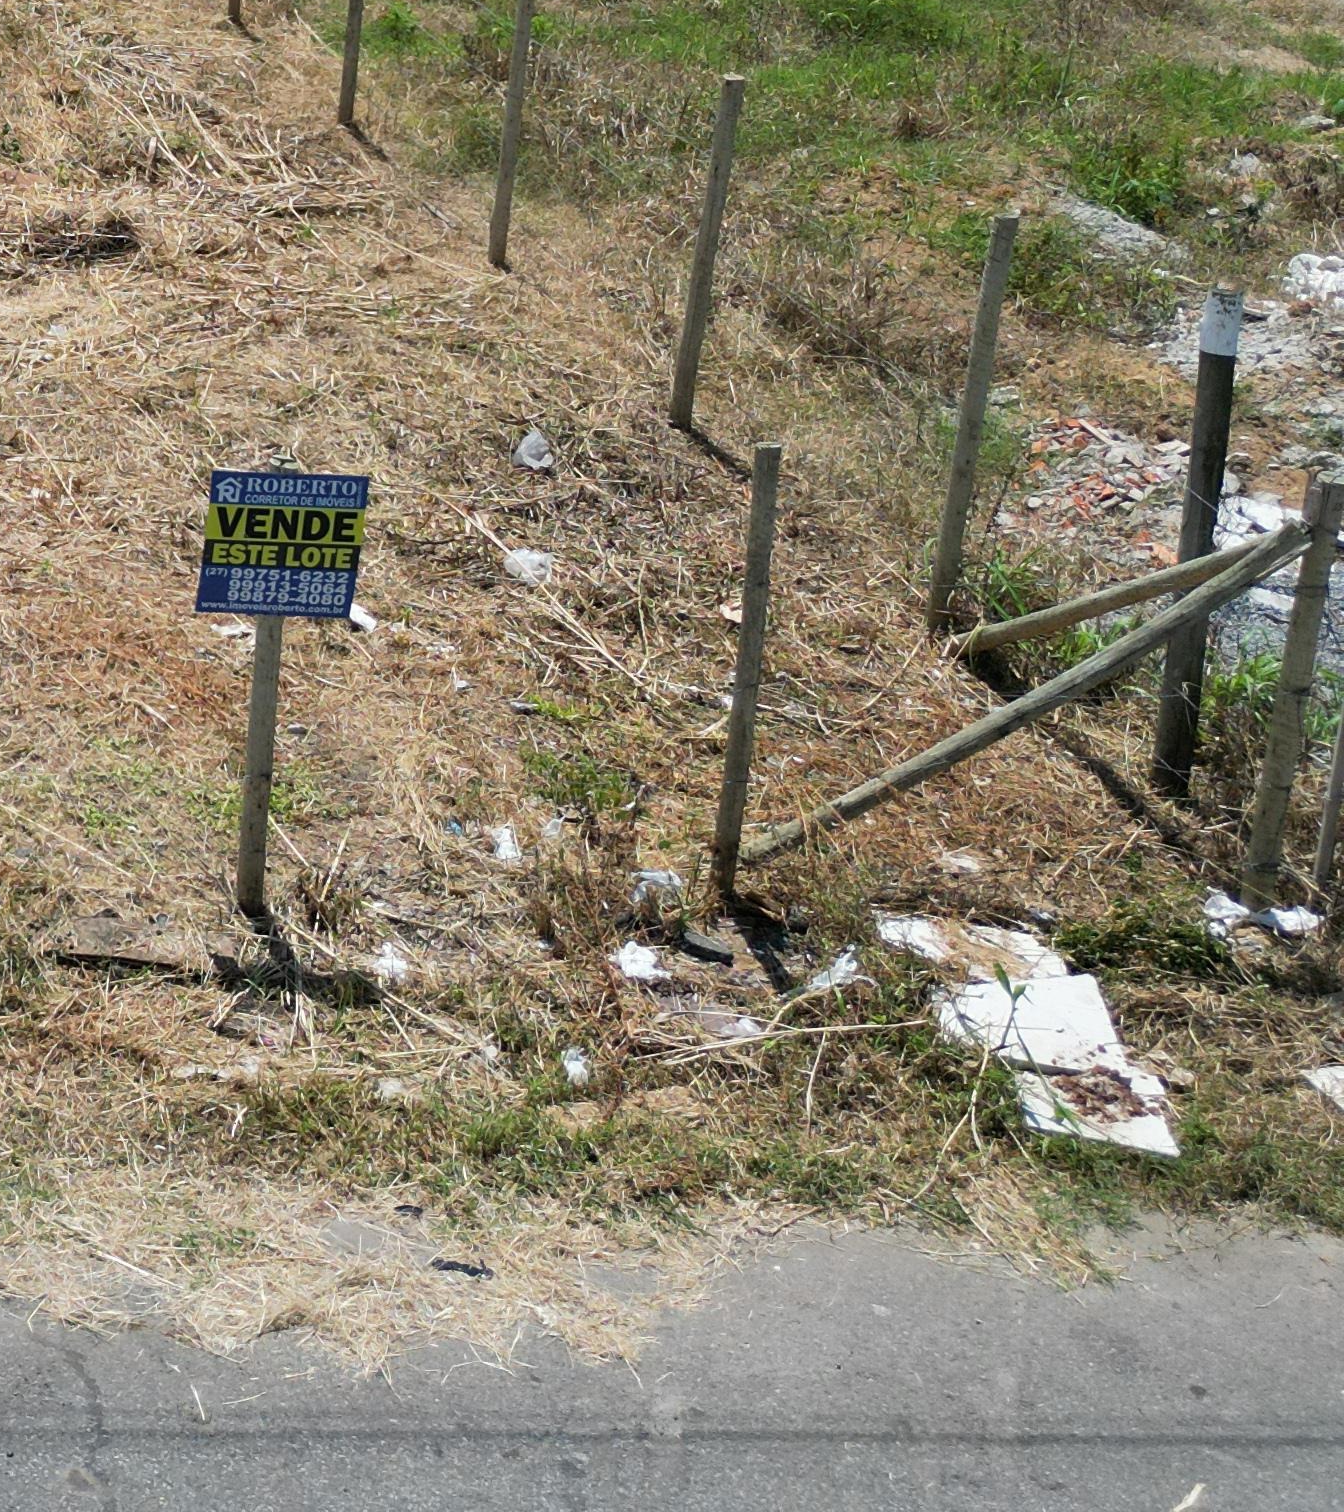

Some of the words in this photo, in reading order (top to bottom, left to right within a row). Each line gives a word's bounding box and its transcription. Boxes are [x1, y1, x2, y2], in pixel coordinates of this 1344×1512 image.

[246, 477, 357, 496] ROBERTO
[244, 494, 298, 505] CORRETOR
[300, 496, 314, 506] DE
[315, 494, 355, 508] IMÓVEIS
[216, 506, 358, 543] VENDE
[211, 542, 279, 566] ESTE
[285, 545, 353, 569] LOTE
[205, 567, 229, 578] (27)
[230, 568, 349, 584] 99751-6232
[228, 579, 347, 595] 99913-5064
[227, 590, 346, 606] 99879-4080
